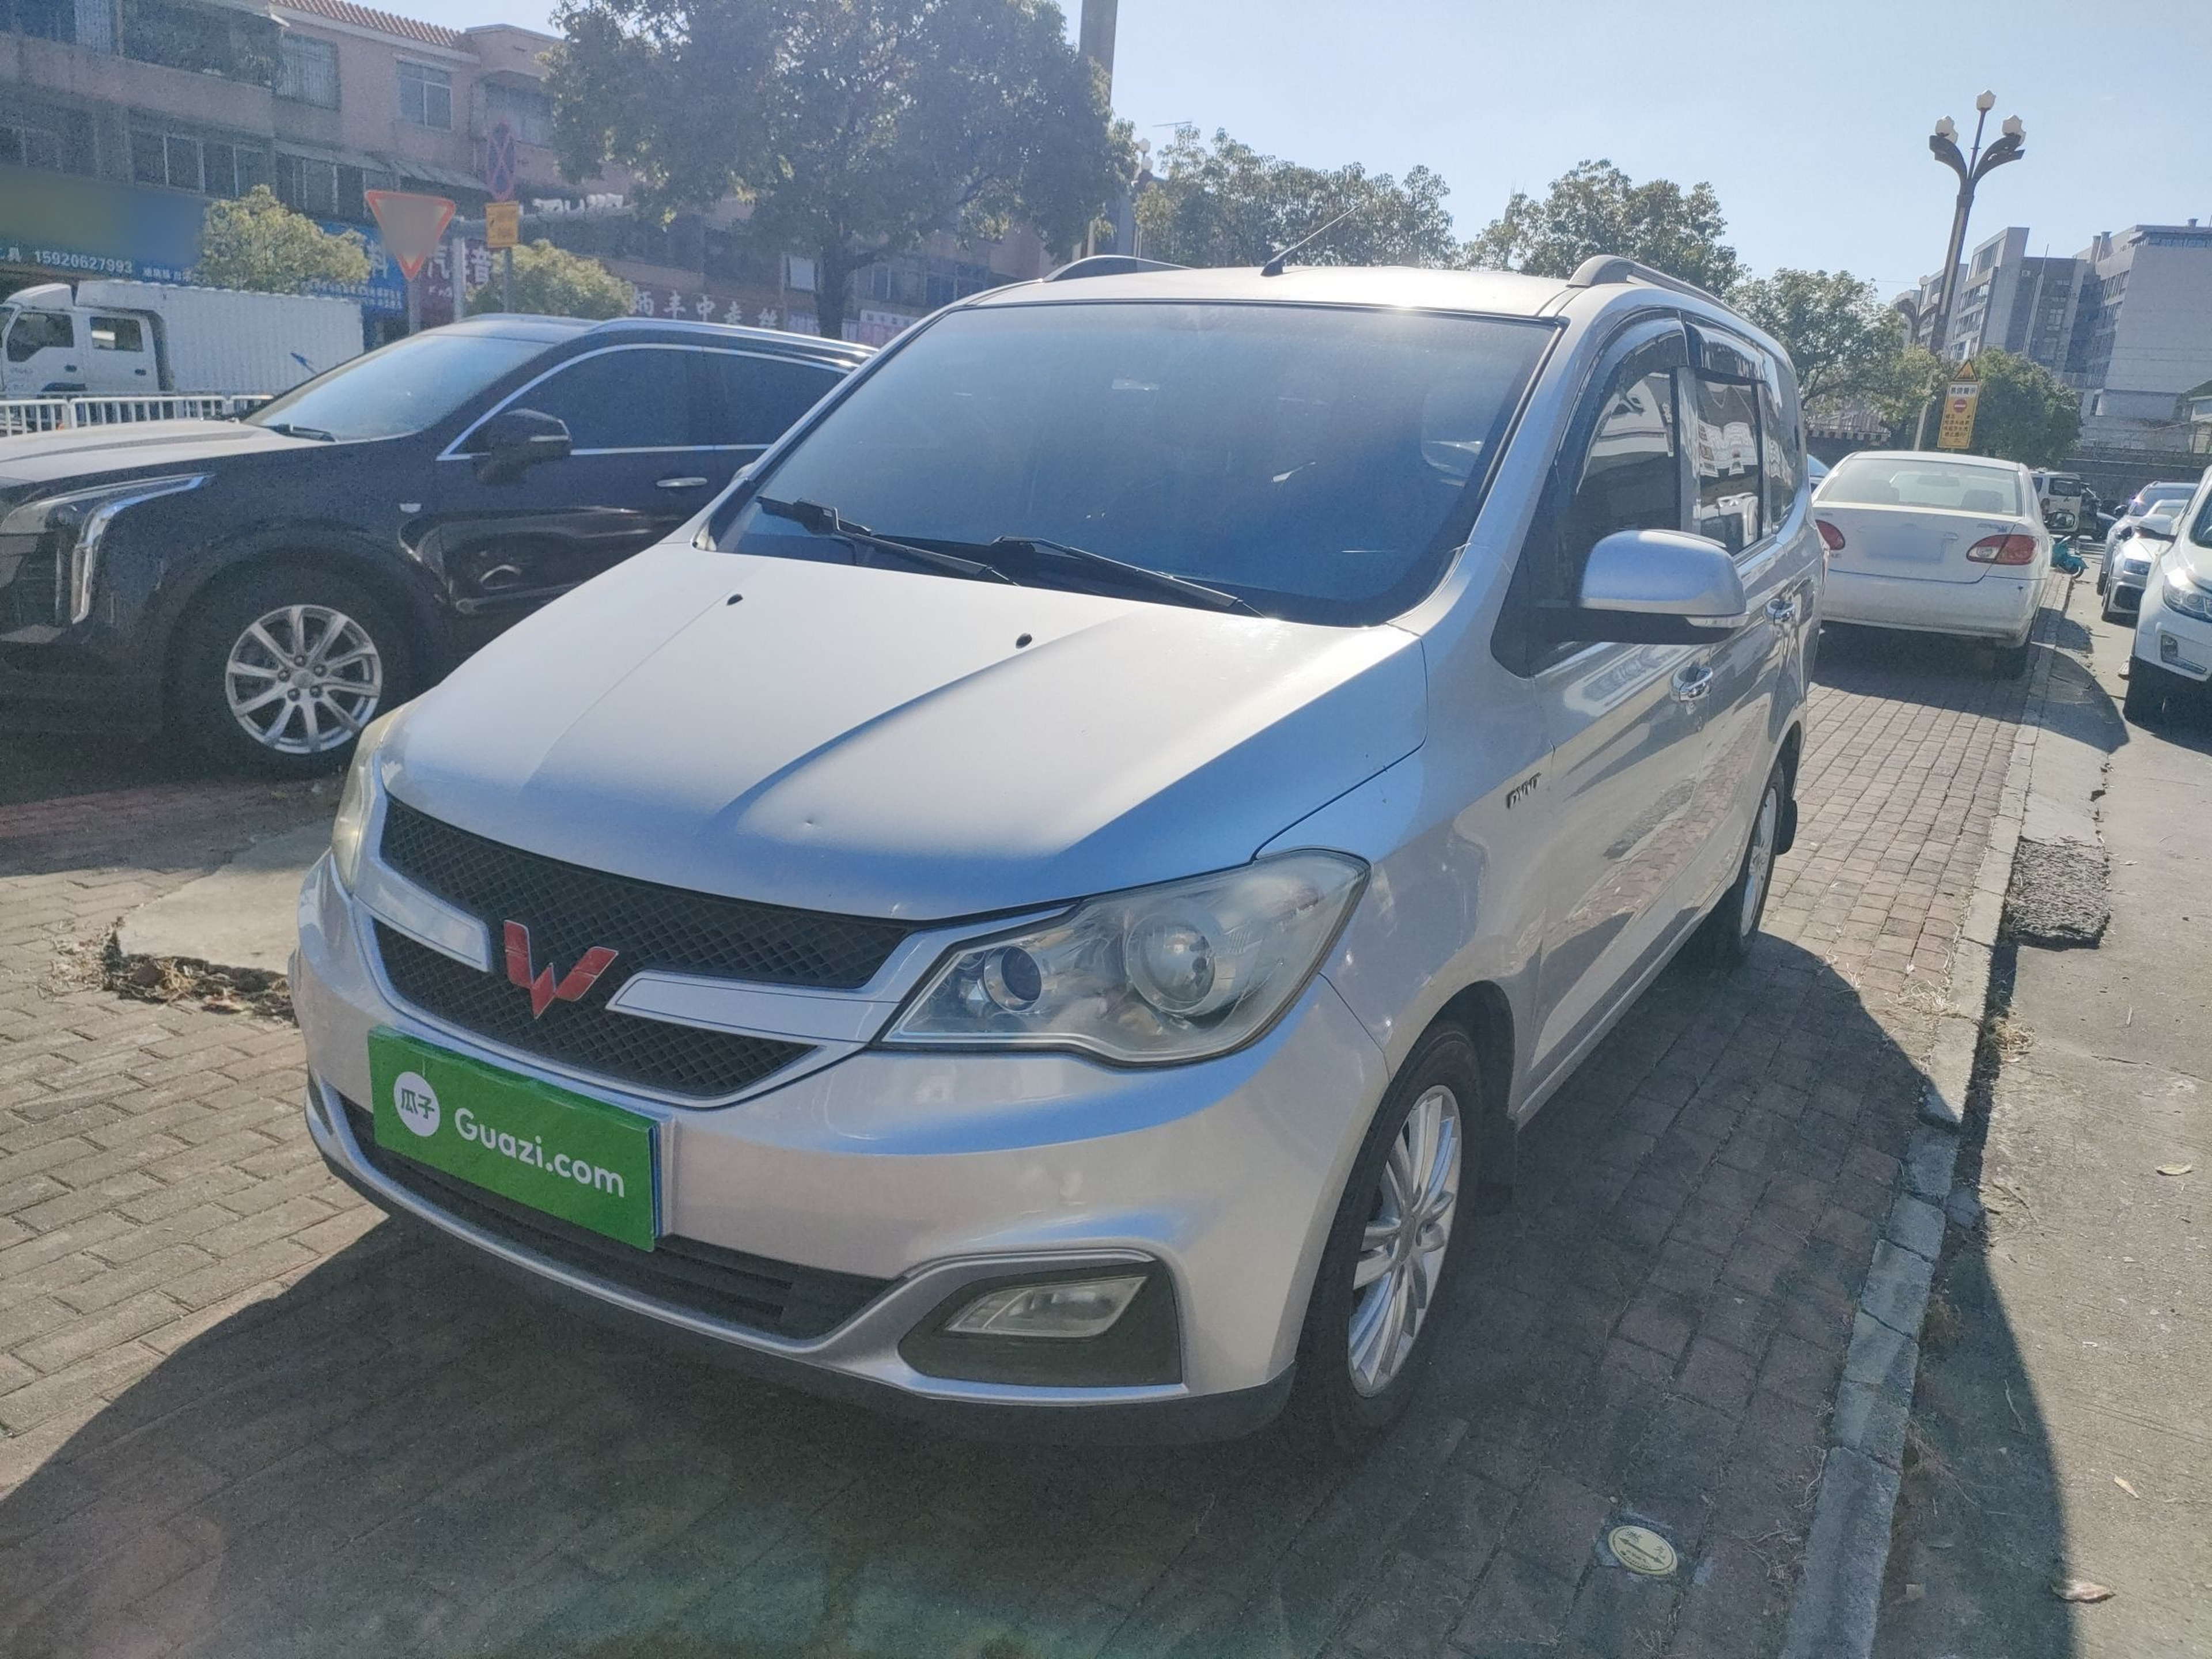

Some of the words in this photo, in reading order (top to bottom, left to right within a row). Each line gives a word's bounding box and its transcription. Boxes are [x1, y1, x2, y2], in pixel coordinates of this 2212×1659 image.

[35, 250, 132, 274] 15920627993
[401, 1088, 435, 1120] 瓜子
[454, 1107, 624, 1198] Guazi.com
